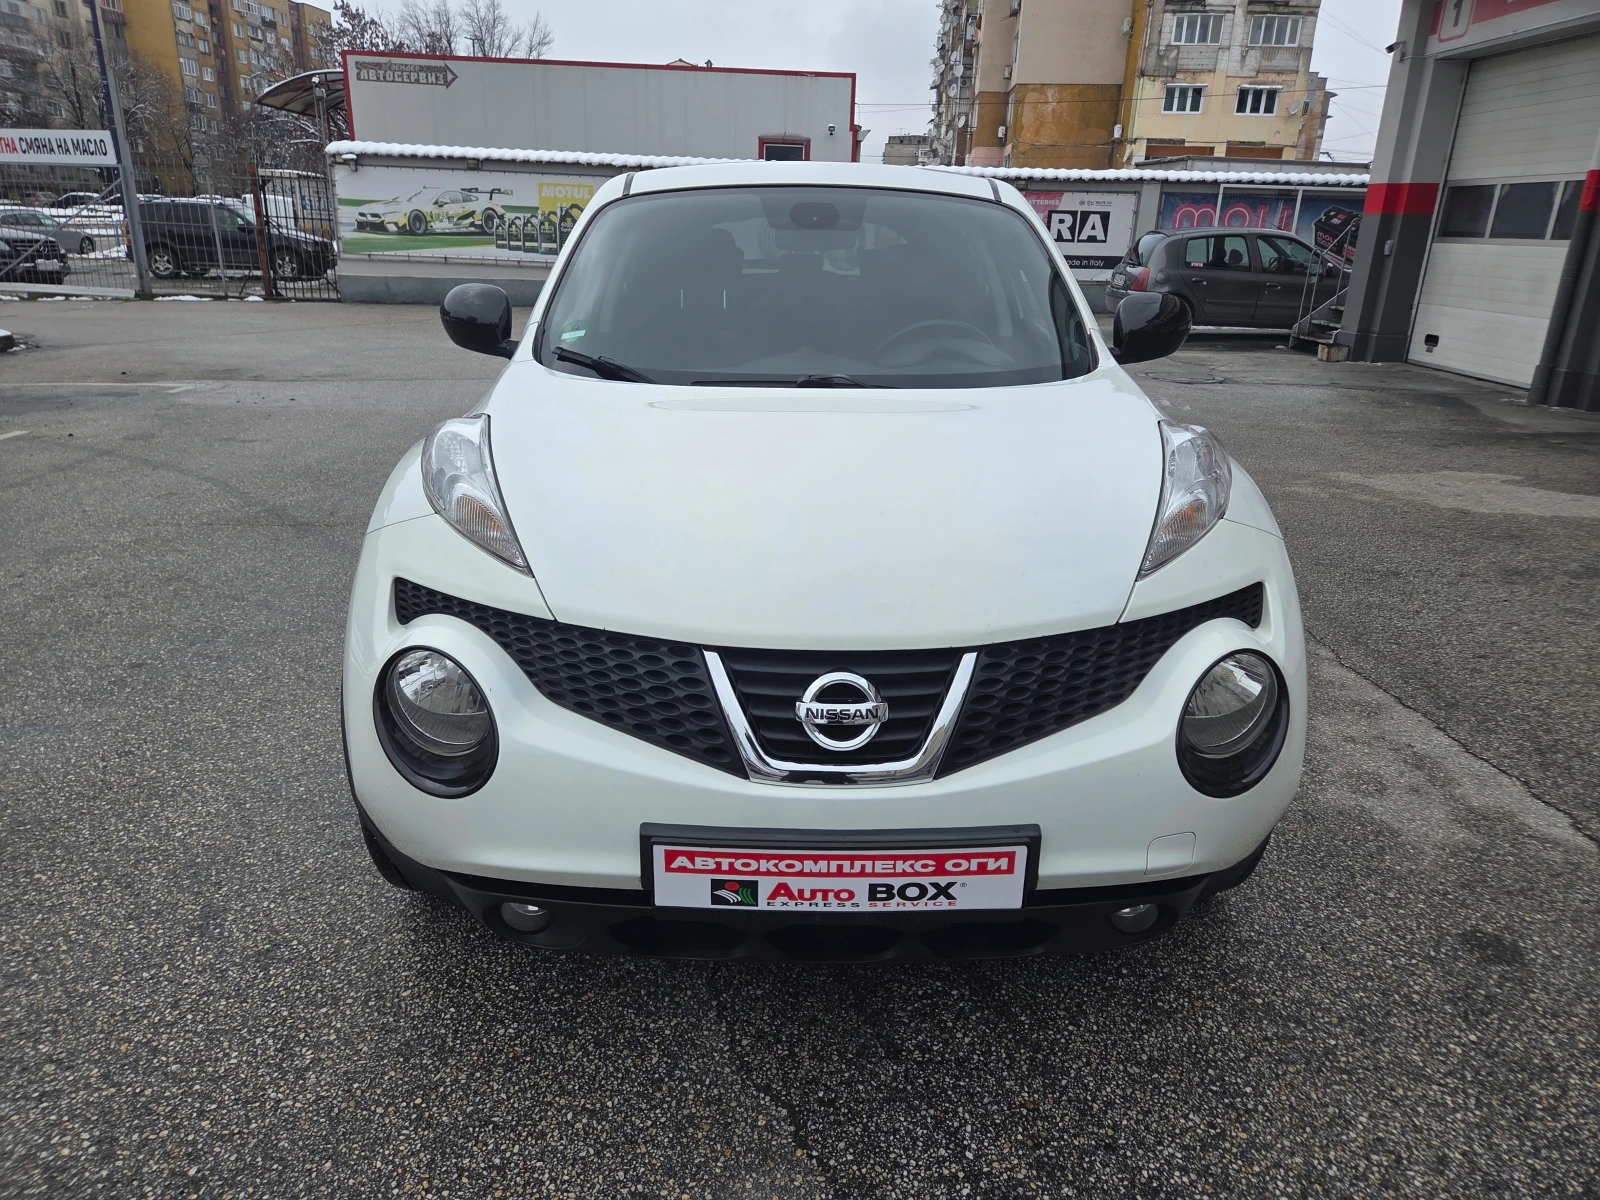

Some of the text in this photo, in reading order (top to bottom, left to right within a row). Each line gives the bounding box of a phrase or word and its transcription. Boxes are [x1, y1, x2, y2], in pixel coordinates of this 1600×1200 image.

[1452, 0, 1463, 27] 1
[360, 69, 446, 84] АВТОСЕРВИЗ
[19, 137, 56, 155] СМЯНА
[55, 138, 71, 155] НА
[71, 138, 108, 156] МАСЛО
[541, 184, 591, 198] MOTUL
[1089, 259, 1105, 267] Italy
[805, 706, 879, 720] NISSAN
[670, 856, 1009, 873] АВТОКОМПЛЕКС ОГИ
